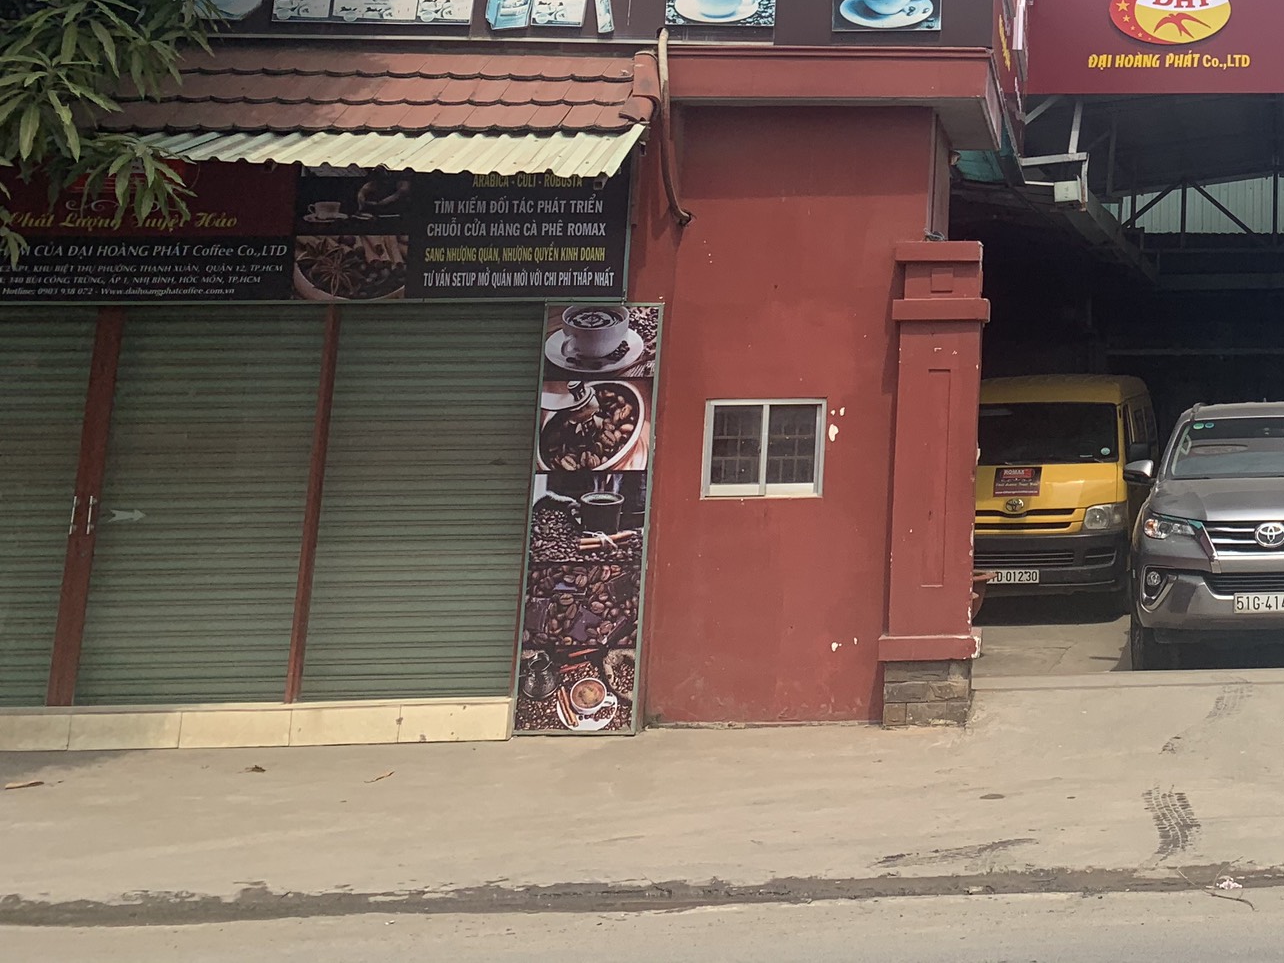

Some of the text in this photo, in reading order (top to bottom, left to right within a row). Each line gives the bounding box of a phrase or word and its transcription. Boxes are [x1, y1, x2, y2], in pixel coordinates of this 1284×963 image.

[1088, 50, 1250, 71] ĐẠI HOÀNG PHÁT Co.,LTD
[434, 193, 604, 214] TÌM KIẾM ĐỐI TÁC PHÁT TRIỂN
[426, 216, 607, 237] CHUỖI CỬA HÀNG CÀ PHÊ ROMAX
[33, 240, 288, 260] CỦA ĐẠI HOÀNG PHÁT Coffee Co.,LTD
[424, 247, 445, 262] SANG
[446, 245, 477, 264] NHƯỢNG
[502, 245, 533, 264] NHƯỢNG
[560, 247, 579, 262] KINH
[580, 247, 606, 262] DOANH
[423, 266, 615, 289] TƯ VẤN SETUP MỞ QUÁN MỚI VỚI CHI PHÍ THẤP NHẤT
